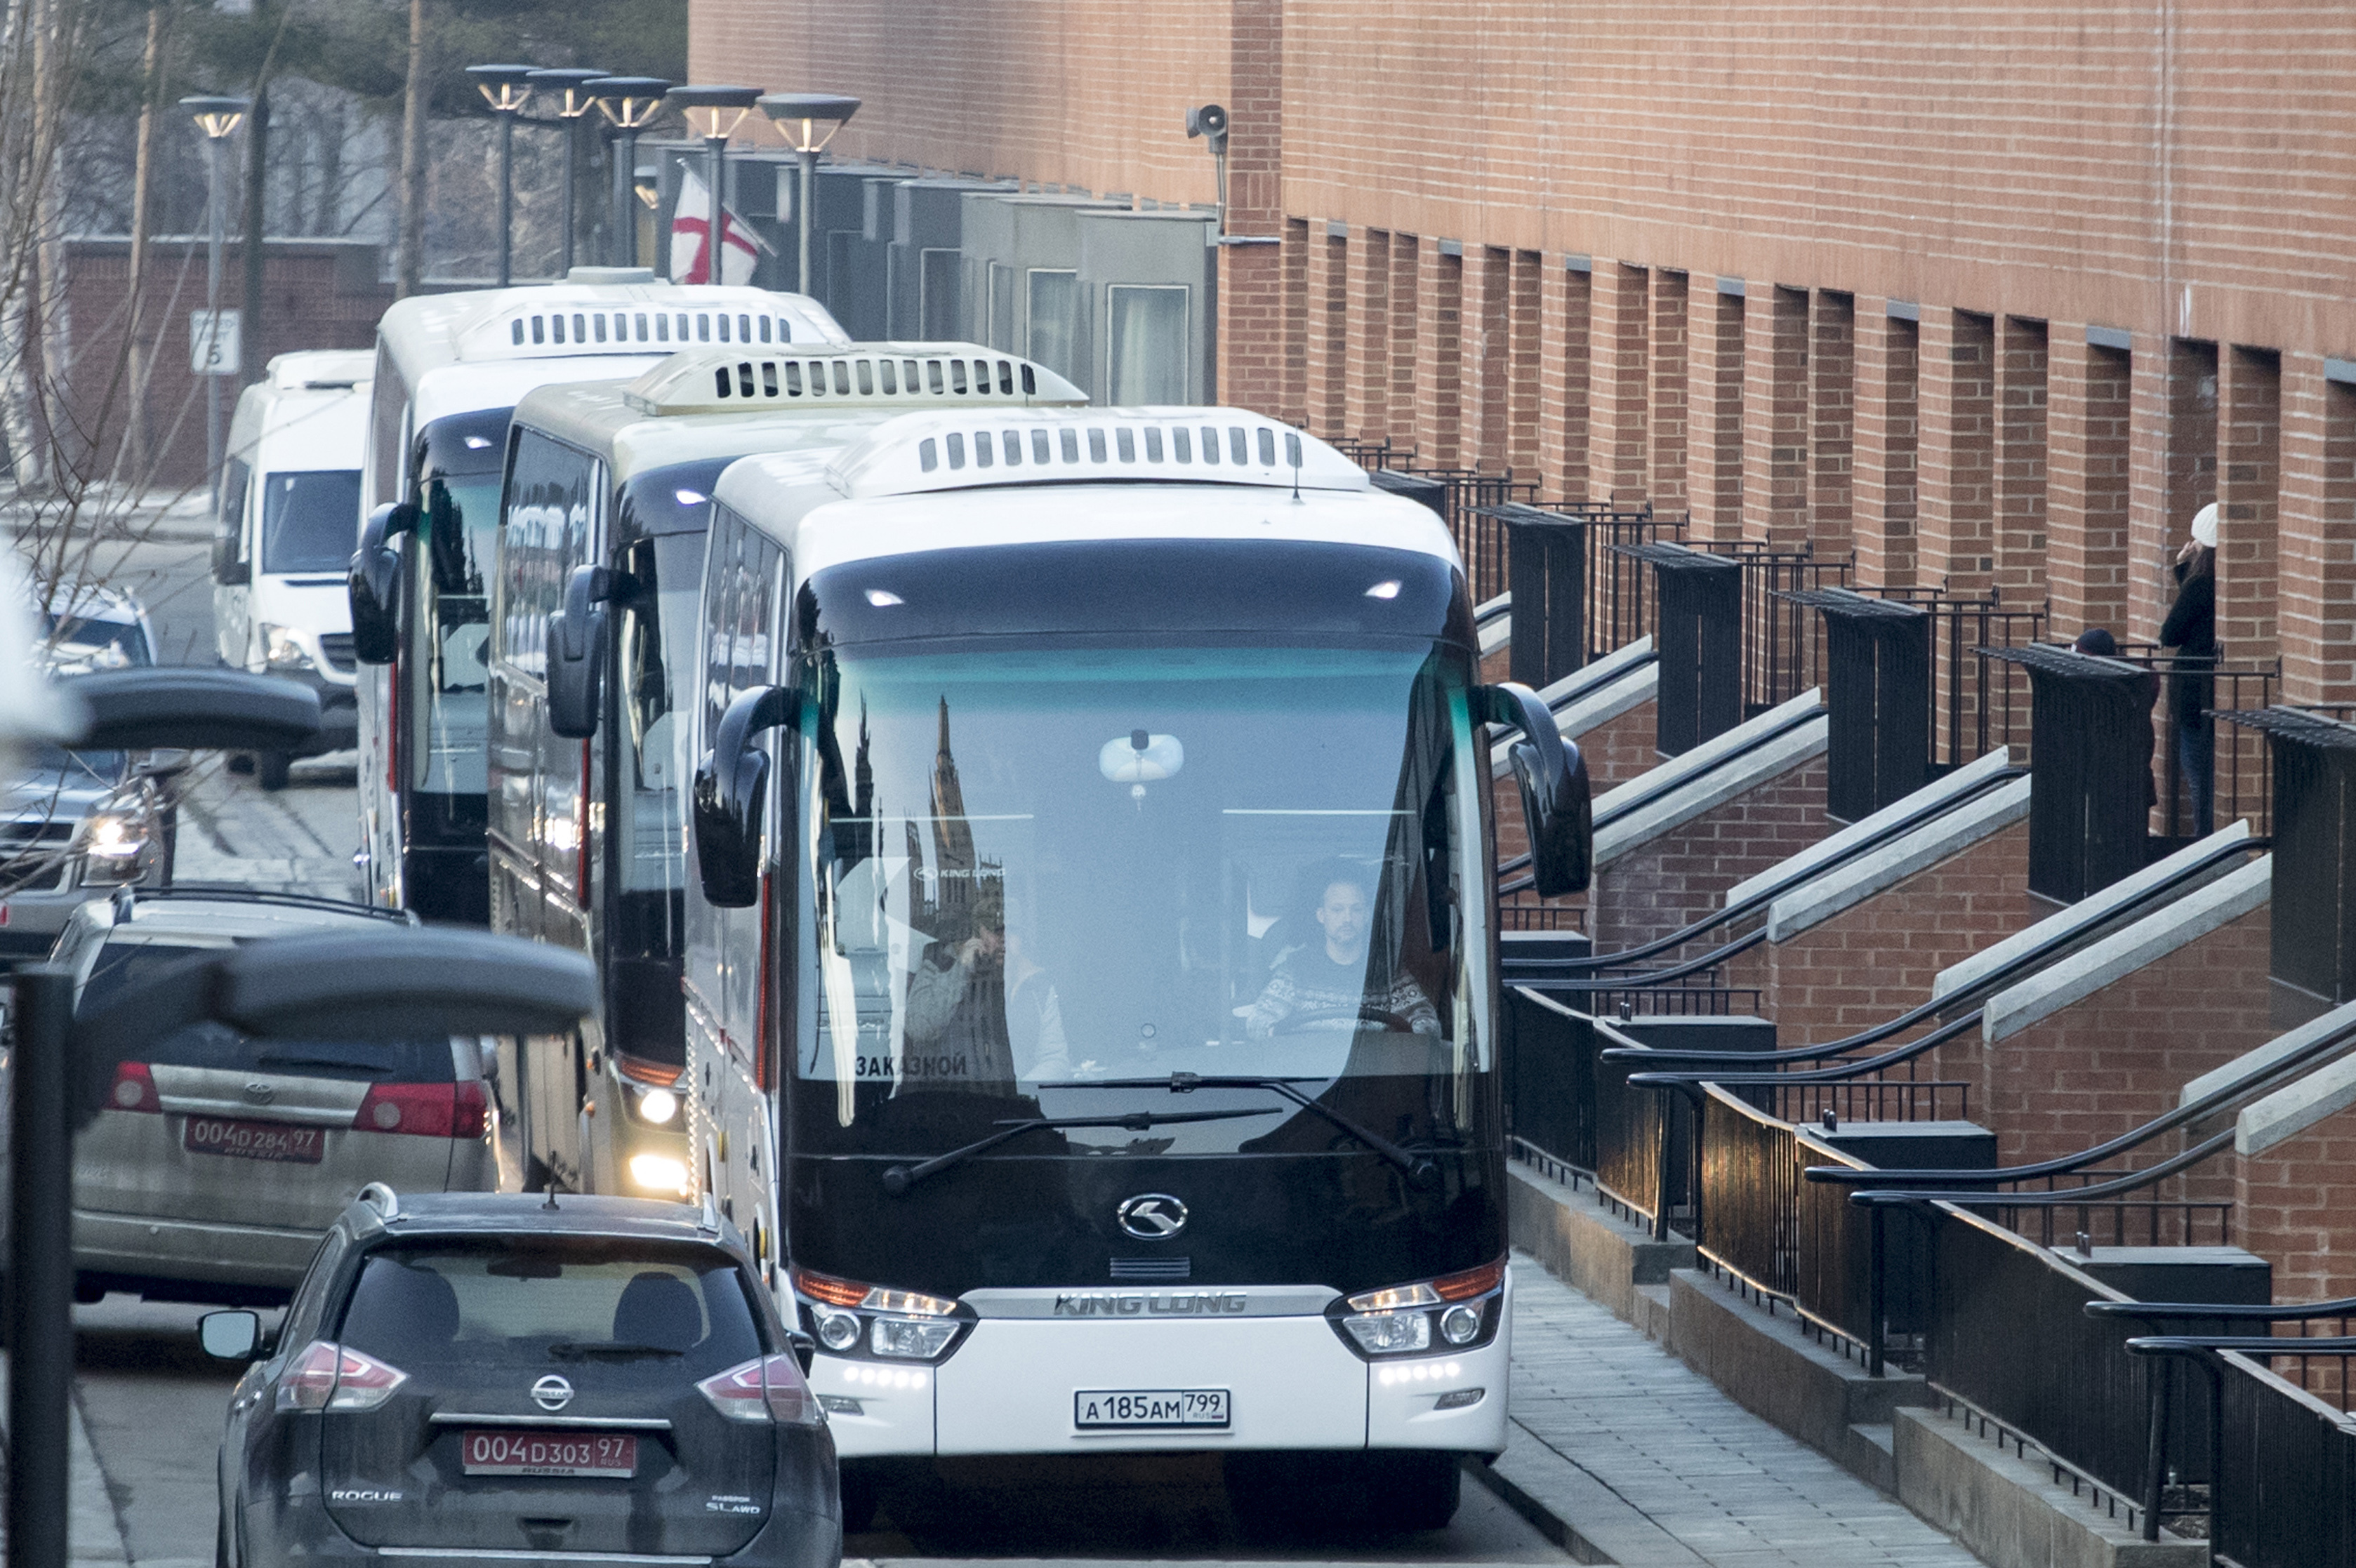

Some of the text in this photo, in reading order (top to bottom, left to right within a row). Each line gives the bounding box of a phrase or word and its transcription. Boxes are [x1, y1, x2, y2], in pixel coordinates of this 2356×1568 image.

[856, 1051, 967, 1077] ЗАКАЗНОЙ
[1054, 1291, 1247, 1315] KING LONG
[1185, 1394, 1221, 1412] 799
[598, 1439, 625, 1458] 97
[332, 1490, 403, 1501] ROGUE
